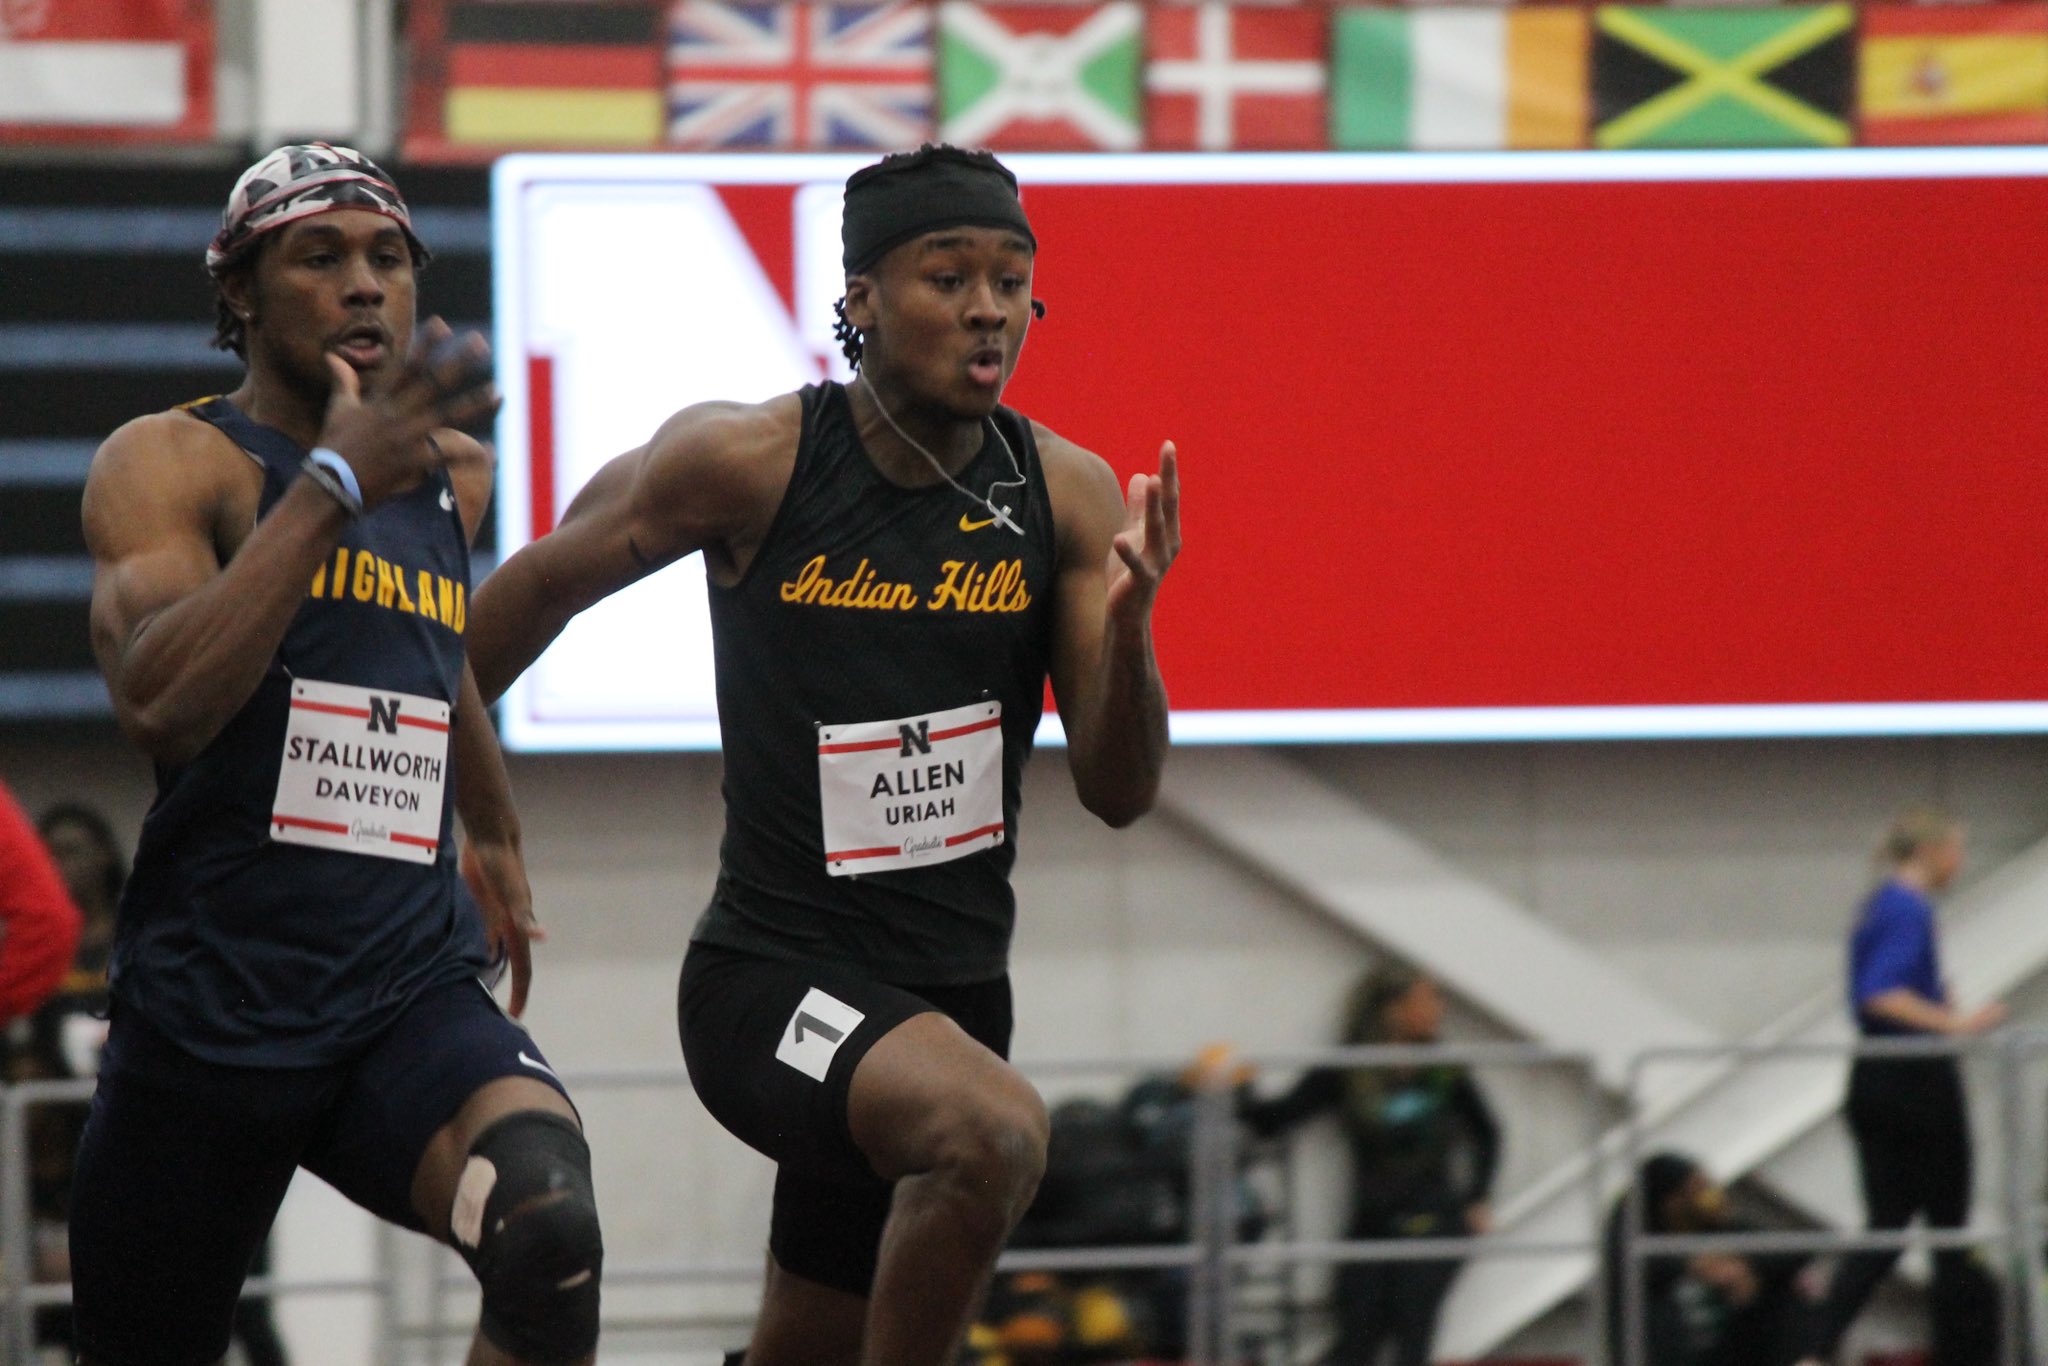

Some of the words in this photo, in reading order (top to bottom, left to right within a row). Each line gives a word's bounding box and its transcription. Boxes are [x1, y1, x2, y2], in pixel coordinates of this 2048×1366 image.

[780, 554, 918, 610] Indian
[927, 558, 1032, 612] Hills
[367, 695, 401, 736] N
[898, 720, 932, 758] N
[287, 736, 442, 783] STALLWORTH
[869, 759, 965, 799] ALLEN
[315, 777, 420, 812] DAVEYON
[886, 797, 955, 826] URIAH
[794, 1010, 846, 1045] 1
